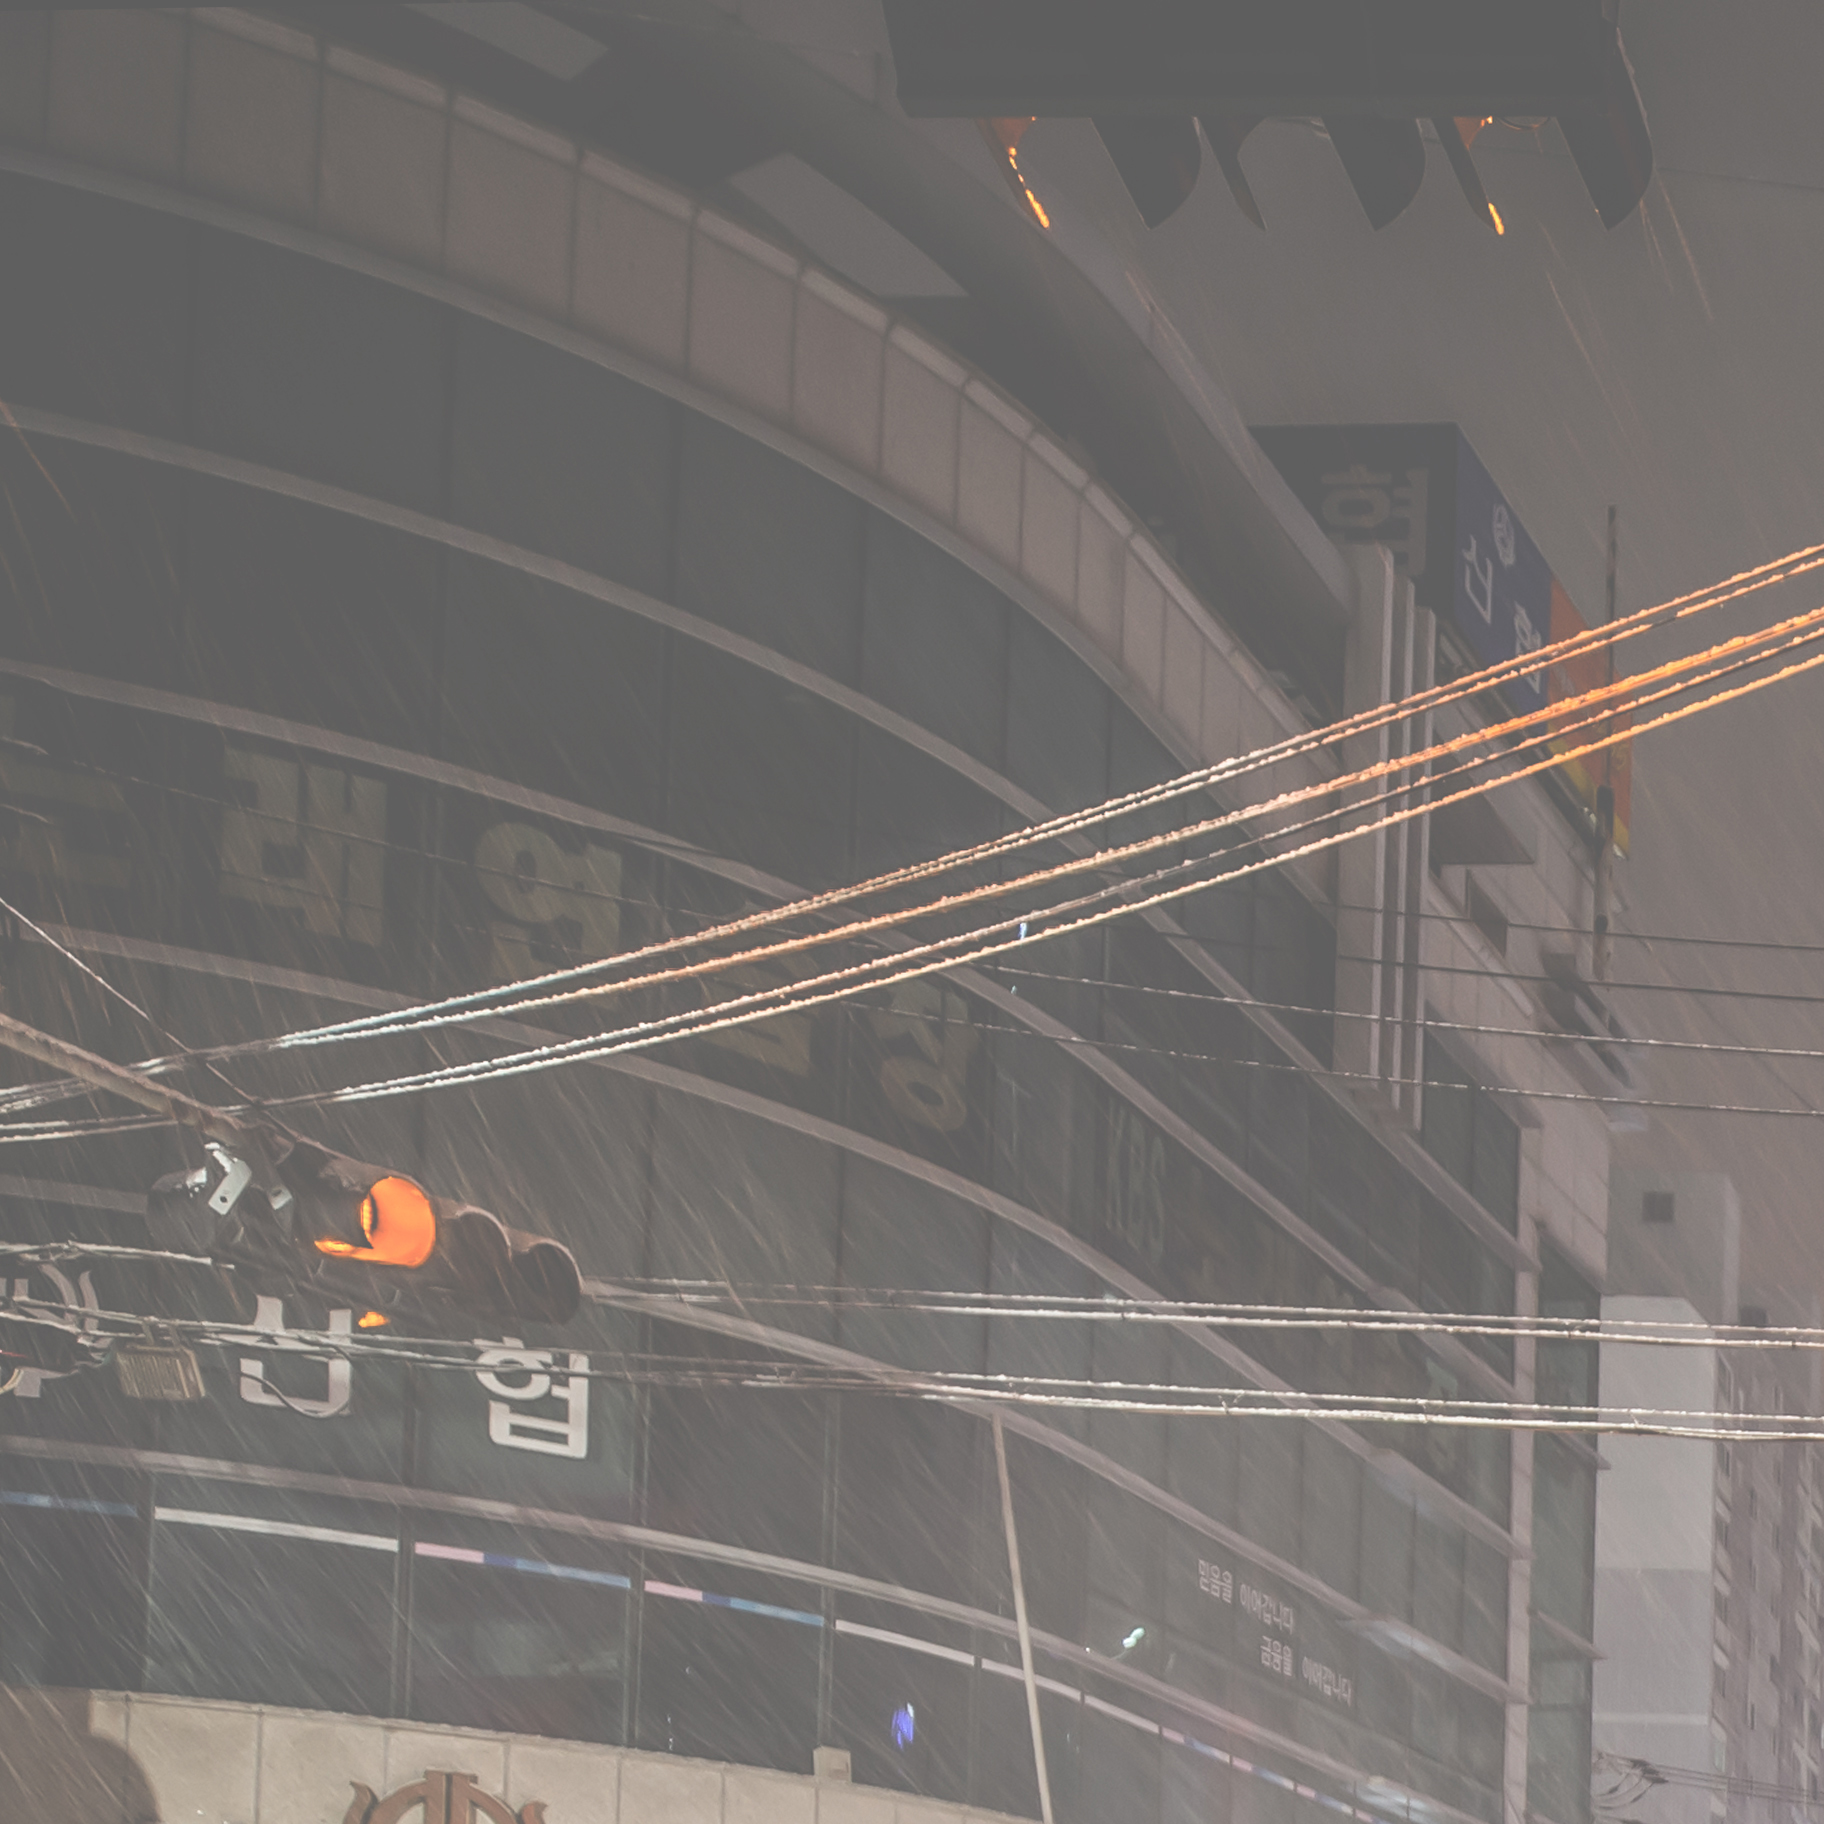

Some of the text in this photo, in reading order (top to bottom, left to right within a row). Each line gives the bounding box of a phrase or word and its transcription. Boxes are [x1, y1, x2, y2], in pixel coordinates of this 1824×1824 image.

[1198, 1558, 1294, 1636] 믿음을 이어갑니다
[1302, 1656, 1352, 1708] 이어갑니다
